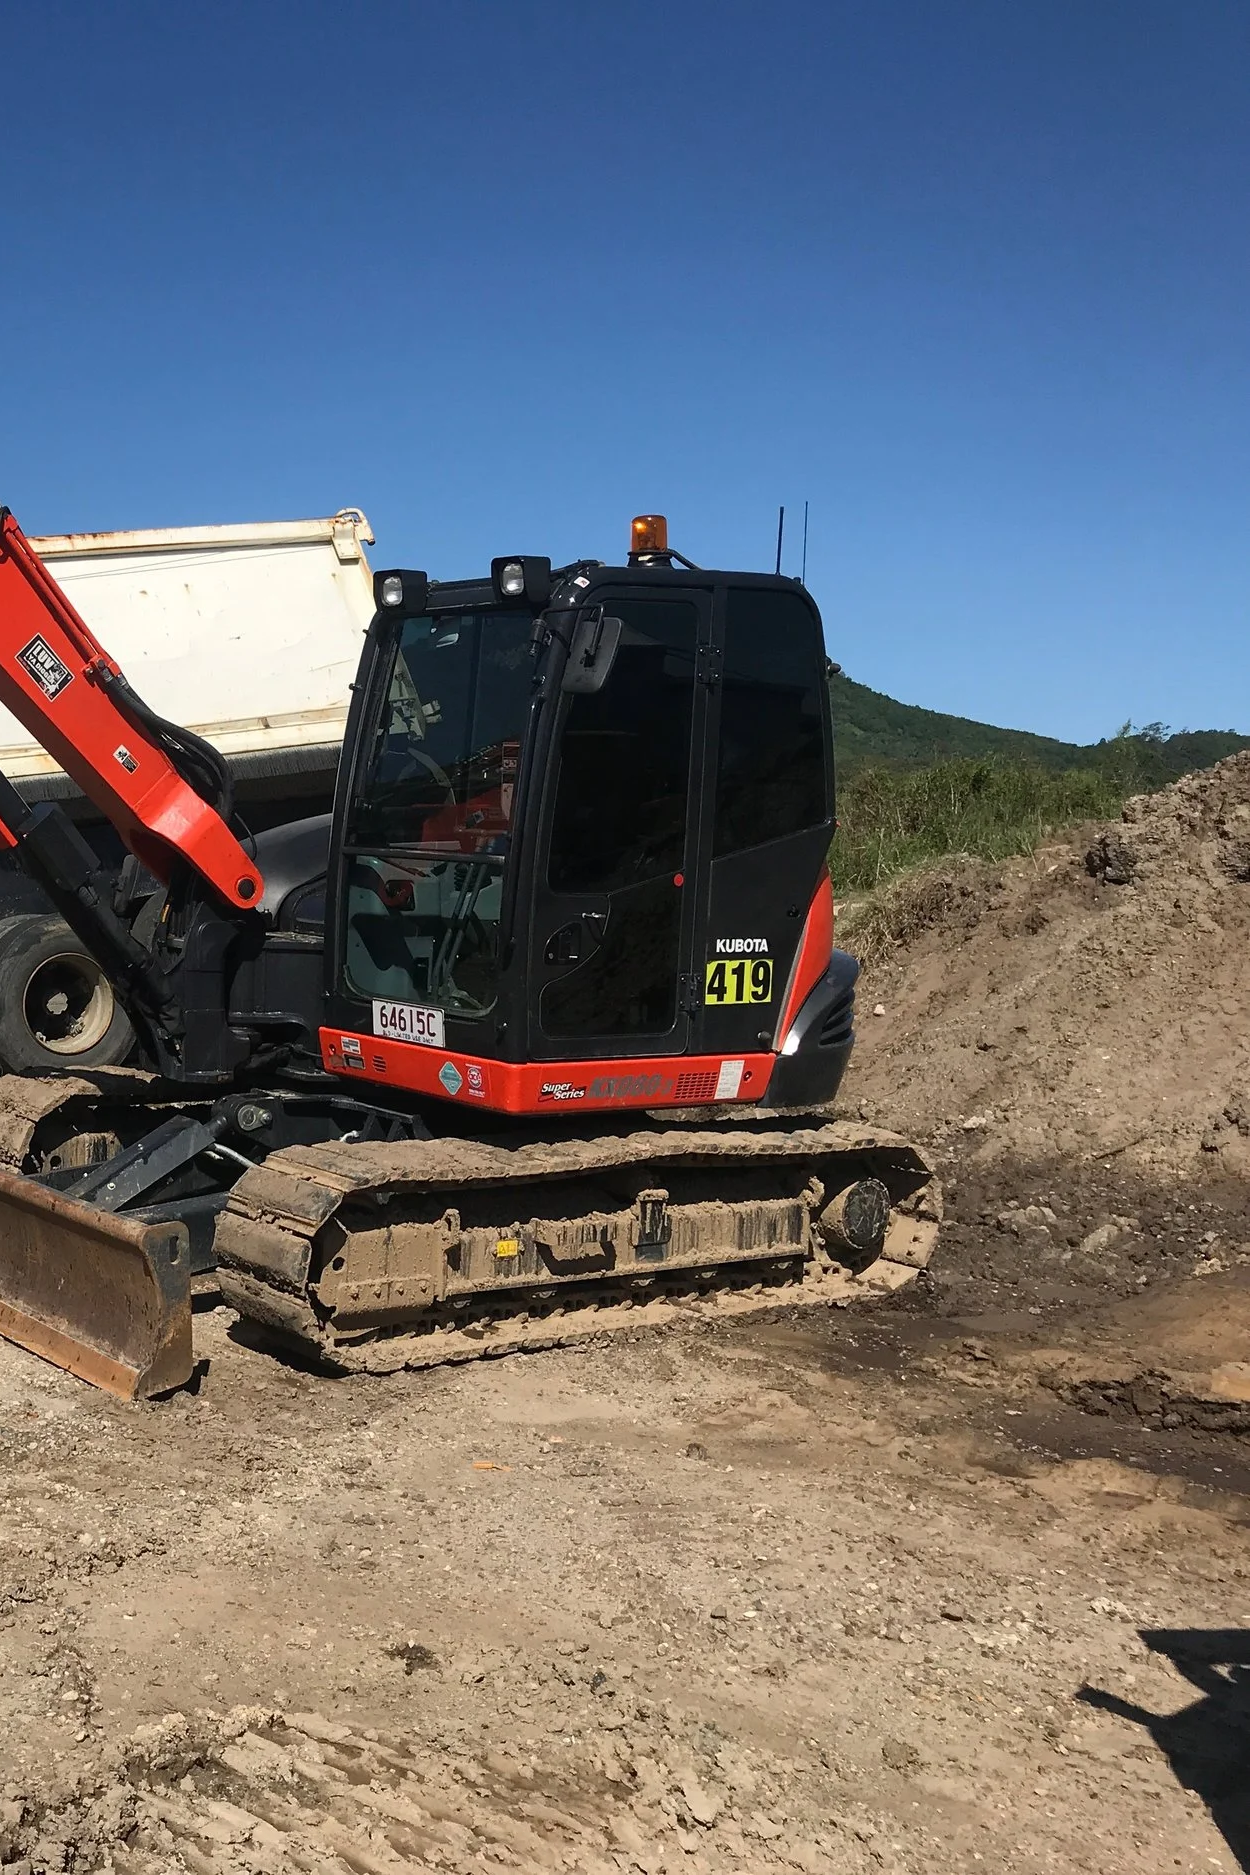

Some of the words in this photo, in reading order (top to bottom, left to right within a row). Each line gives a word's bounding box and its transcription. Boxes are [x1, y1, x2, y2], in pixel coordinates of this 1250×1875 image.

[28, 653, 37, 666] YA
[32, 644, 55, 670] LUV
[716, 938, 769, 953] KUBOTA
[707, 960, 771, 1002] 419
[380, 1004, 437, 1038] 64615C
[541, 1082, 572, 1093] Super
[553, 1088, 585, 1100] Series
